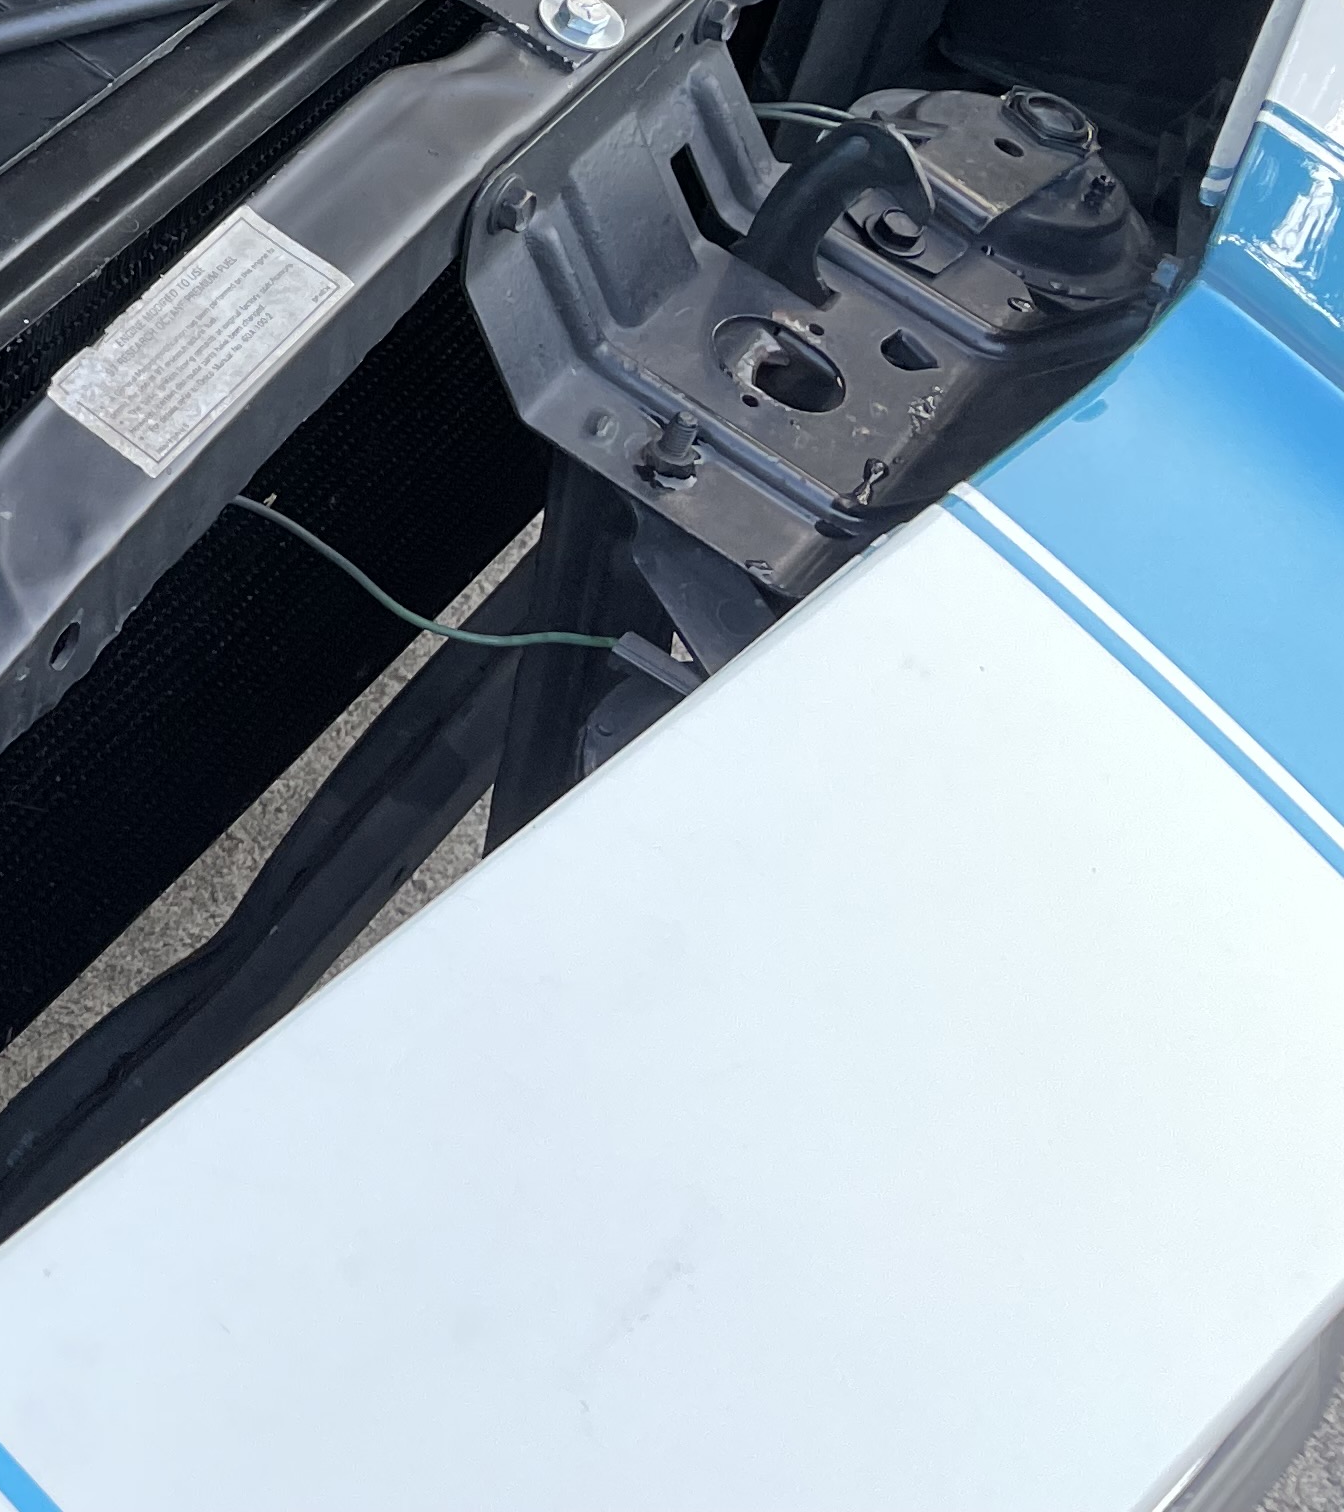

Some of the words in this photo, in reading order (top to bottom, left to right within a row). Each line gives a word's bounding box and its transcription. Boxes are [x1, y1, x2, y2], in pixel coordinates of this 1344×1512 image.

[114, 319, 145, 347] ENGINE
[175, 277, 191, 291] TO
[186, 264, 205, 281] USE
[115, 327, 159, 366] RESEARCH
[183, 269, 220, 303] PREMIUM
[215, 254, 238, 273] FUEL
